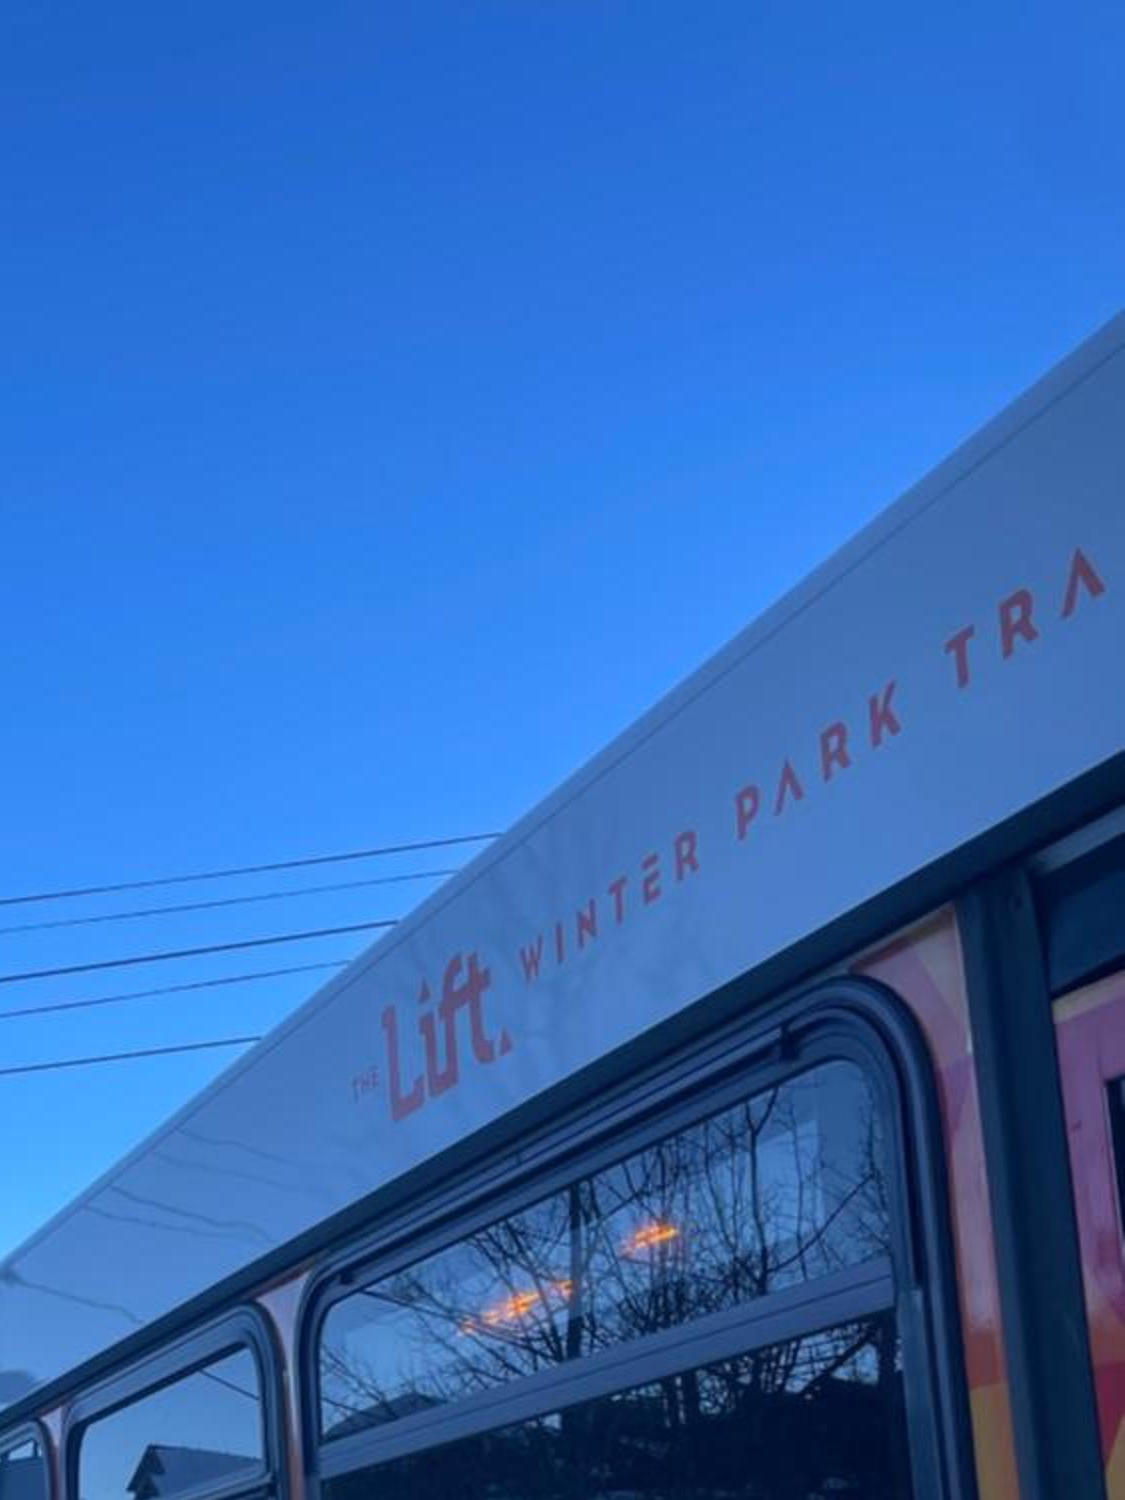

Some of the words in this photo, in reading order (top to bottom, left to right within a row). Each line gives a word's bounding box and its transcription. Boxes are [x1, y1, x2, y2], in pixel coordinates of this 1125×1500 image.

[518, 831, 700, 987] WINTER
[733, 679, 902, 842] PARK
[943, 546, 1106, 689] TRA
